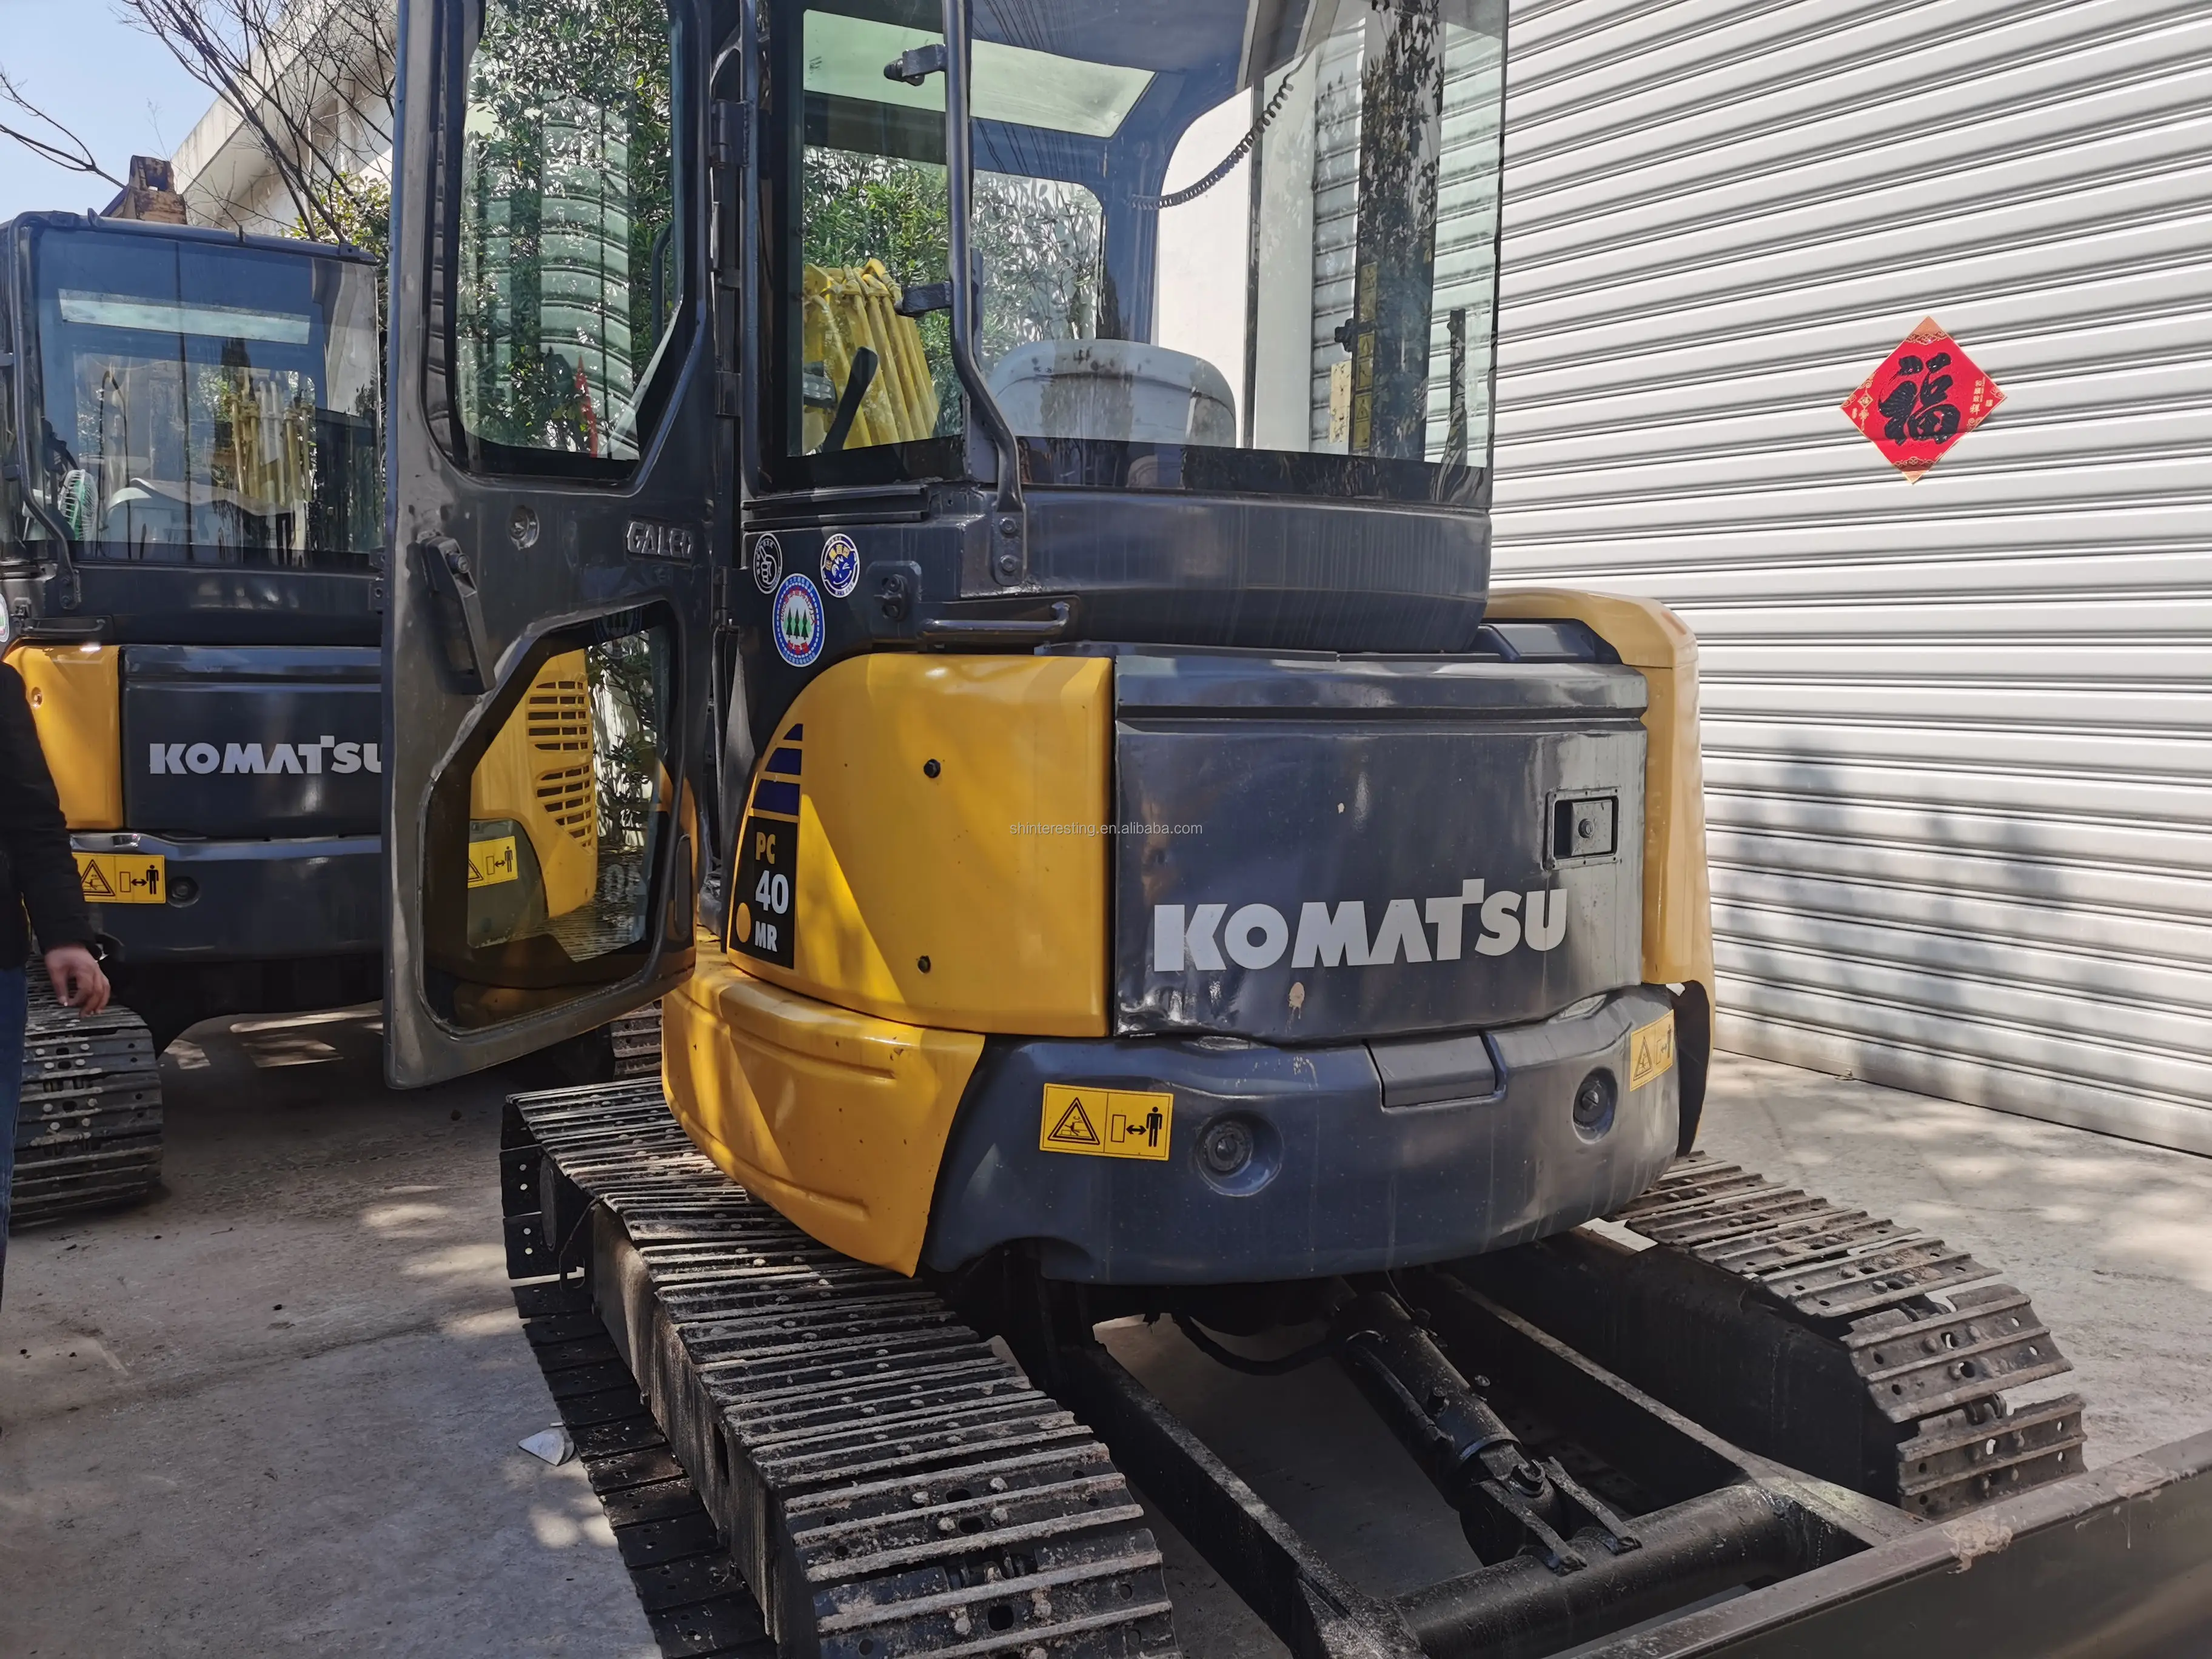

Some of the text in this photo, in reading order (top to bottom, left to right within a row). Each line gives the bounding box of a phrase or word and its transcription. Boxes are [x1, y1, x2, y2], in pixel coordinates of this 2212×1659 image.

[1879, 352, 1960, 446] 福
[149, 735, 381, 774] KOMATSU
[756, 831, 776, 865] PC
[755, 870, 789, 914] 40
[754, 920, 777, 953] MR
[1154, 878, 1567, 972] KOMATSU
